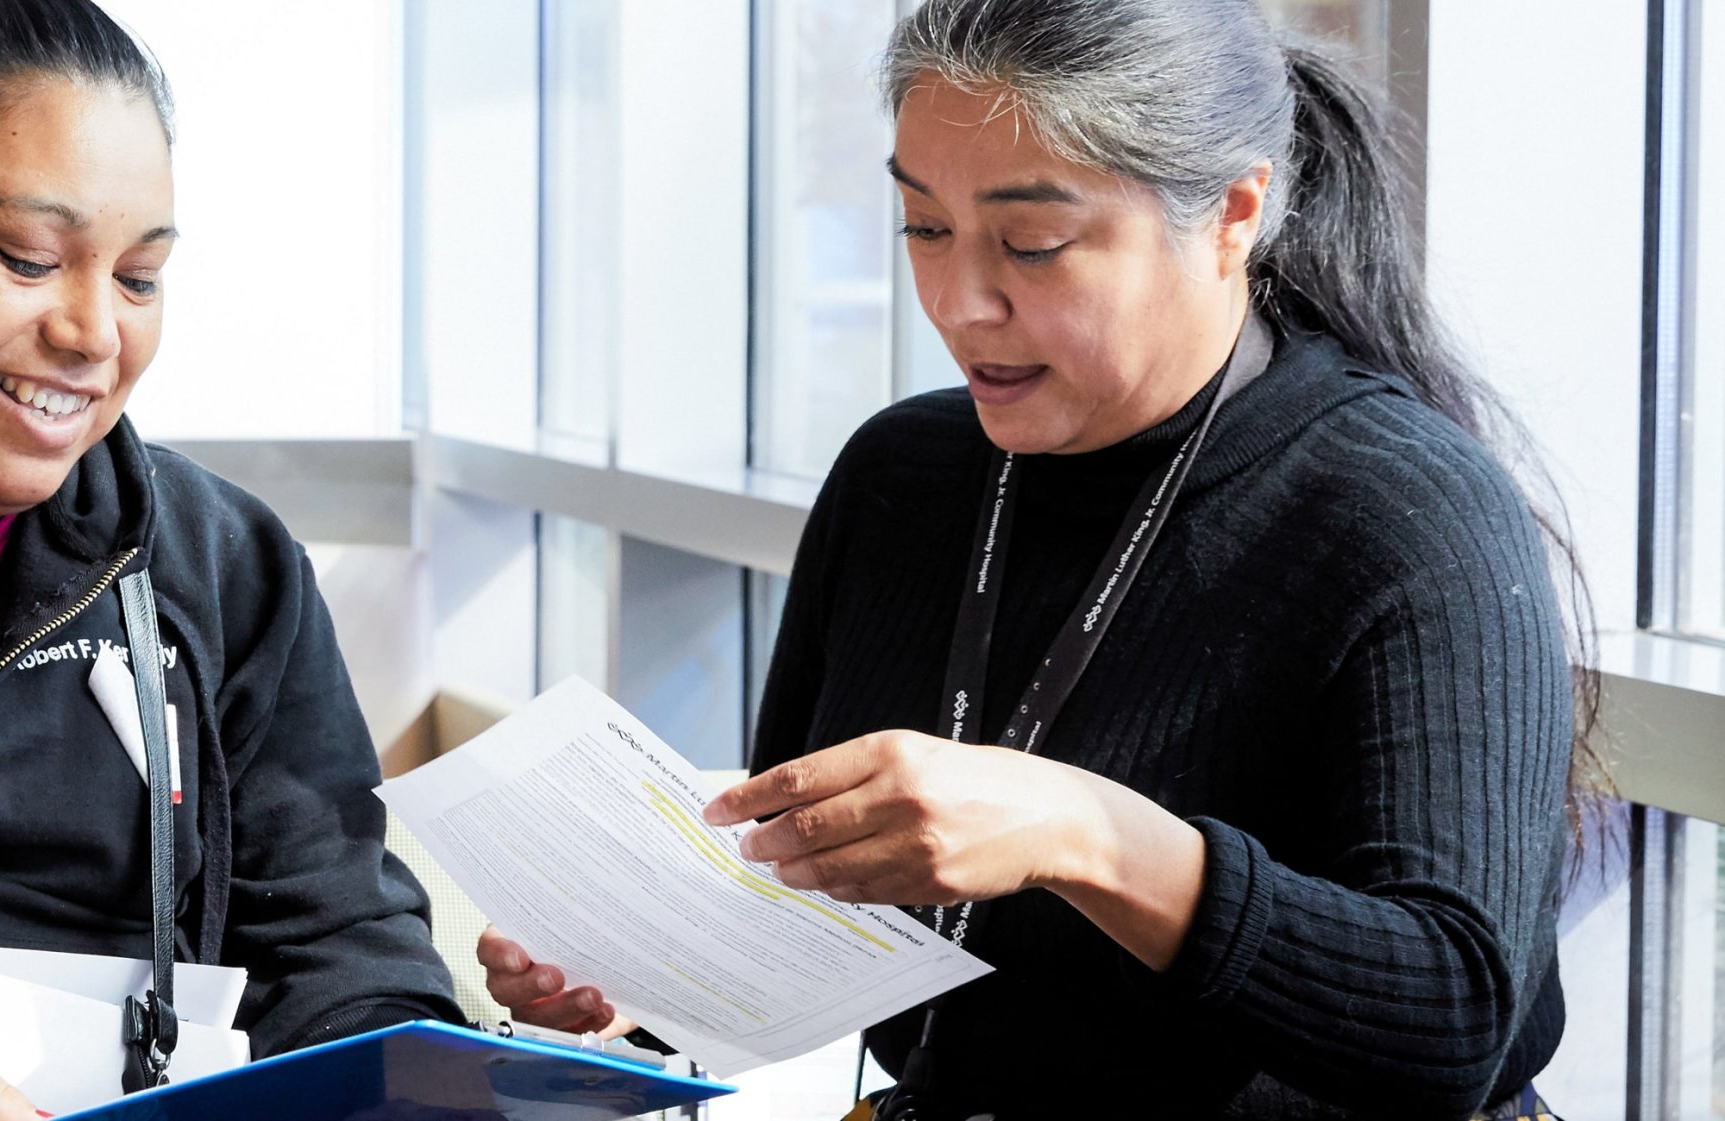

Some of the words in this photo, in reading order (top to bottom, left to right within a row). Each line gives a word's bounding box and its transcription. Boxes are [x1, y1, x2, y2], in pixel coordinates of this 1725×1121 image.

[984, 499, 1004, 552] Community
[1097, 572, 1120, 604] Martin
[1115, 542, 1136, 574] Luther
[1151, 452, 1184, 506] Community
[977, 553, 992, 593] Hospital
[78, 639, 97, 659] F.
[646, 753, 698, 791] Martin
[867, 911, 925, 947] Hospital
